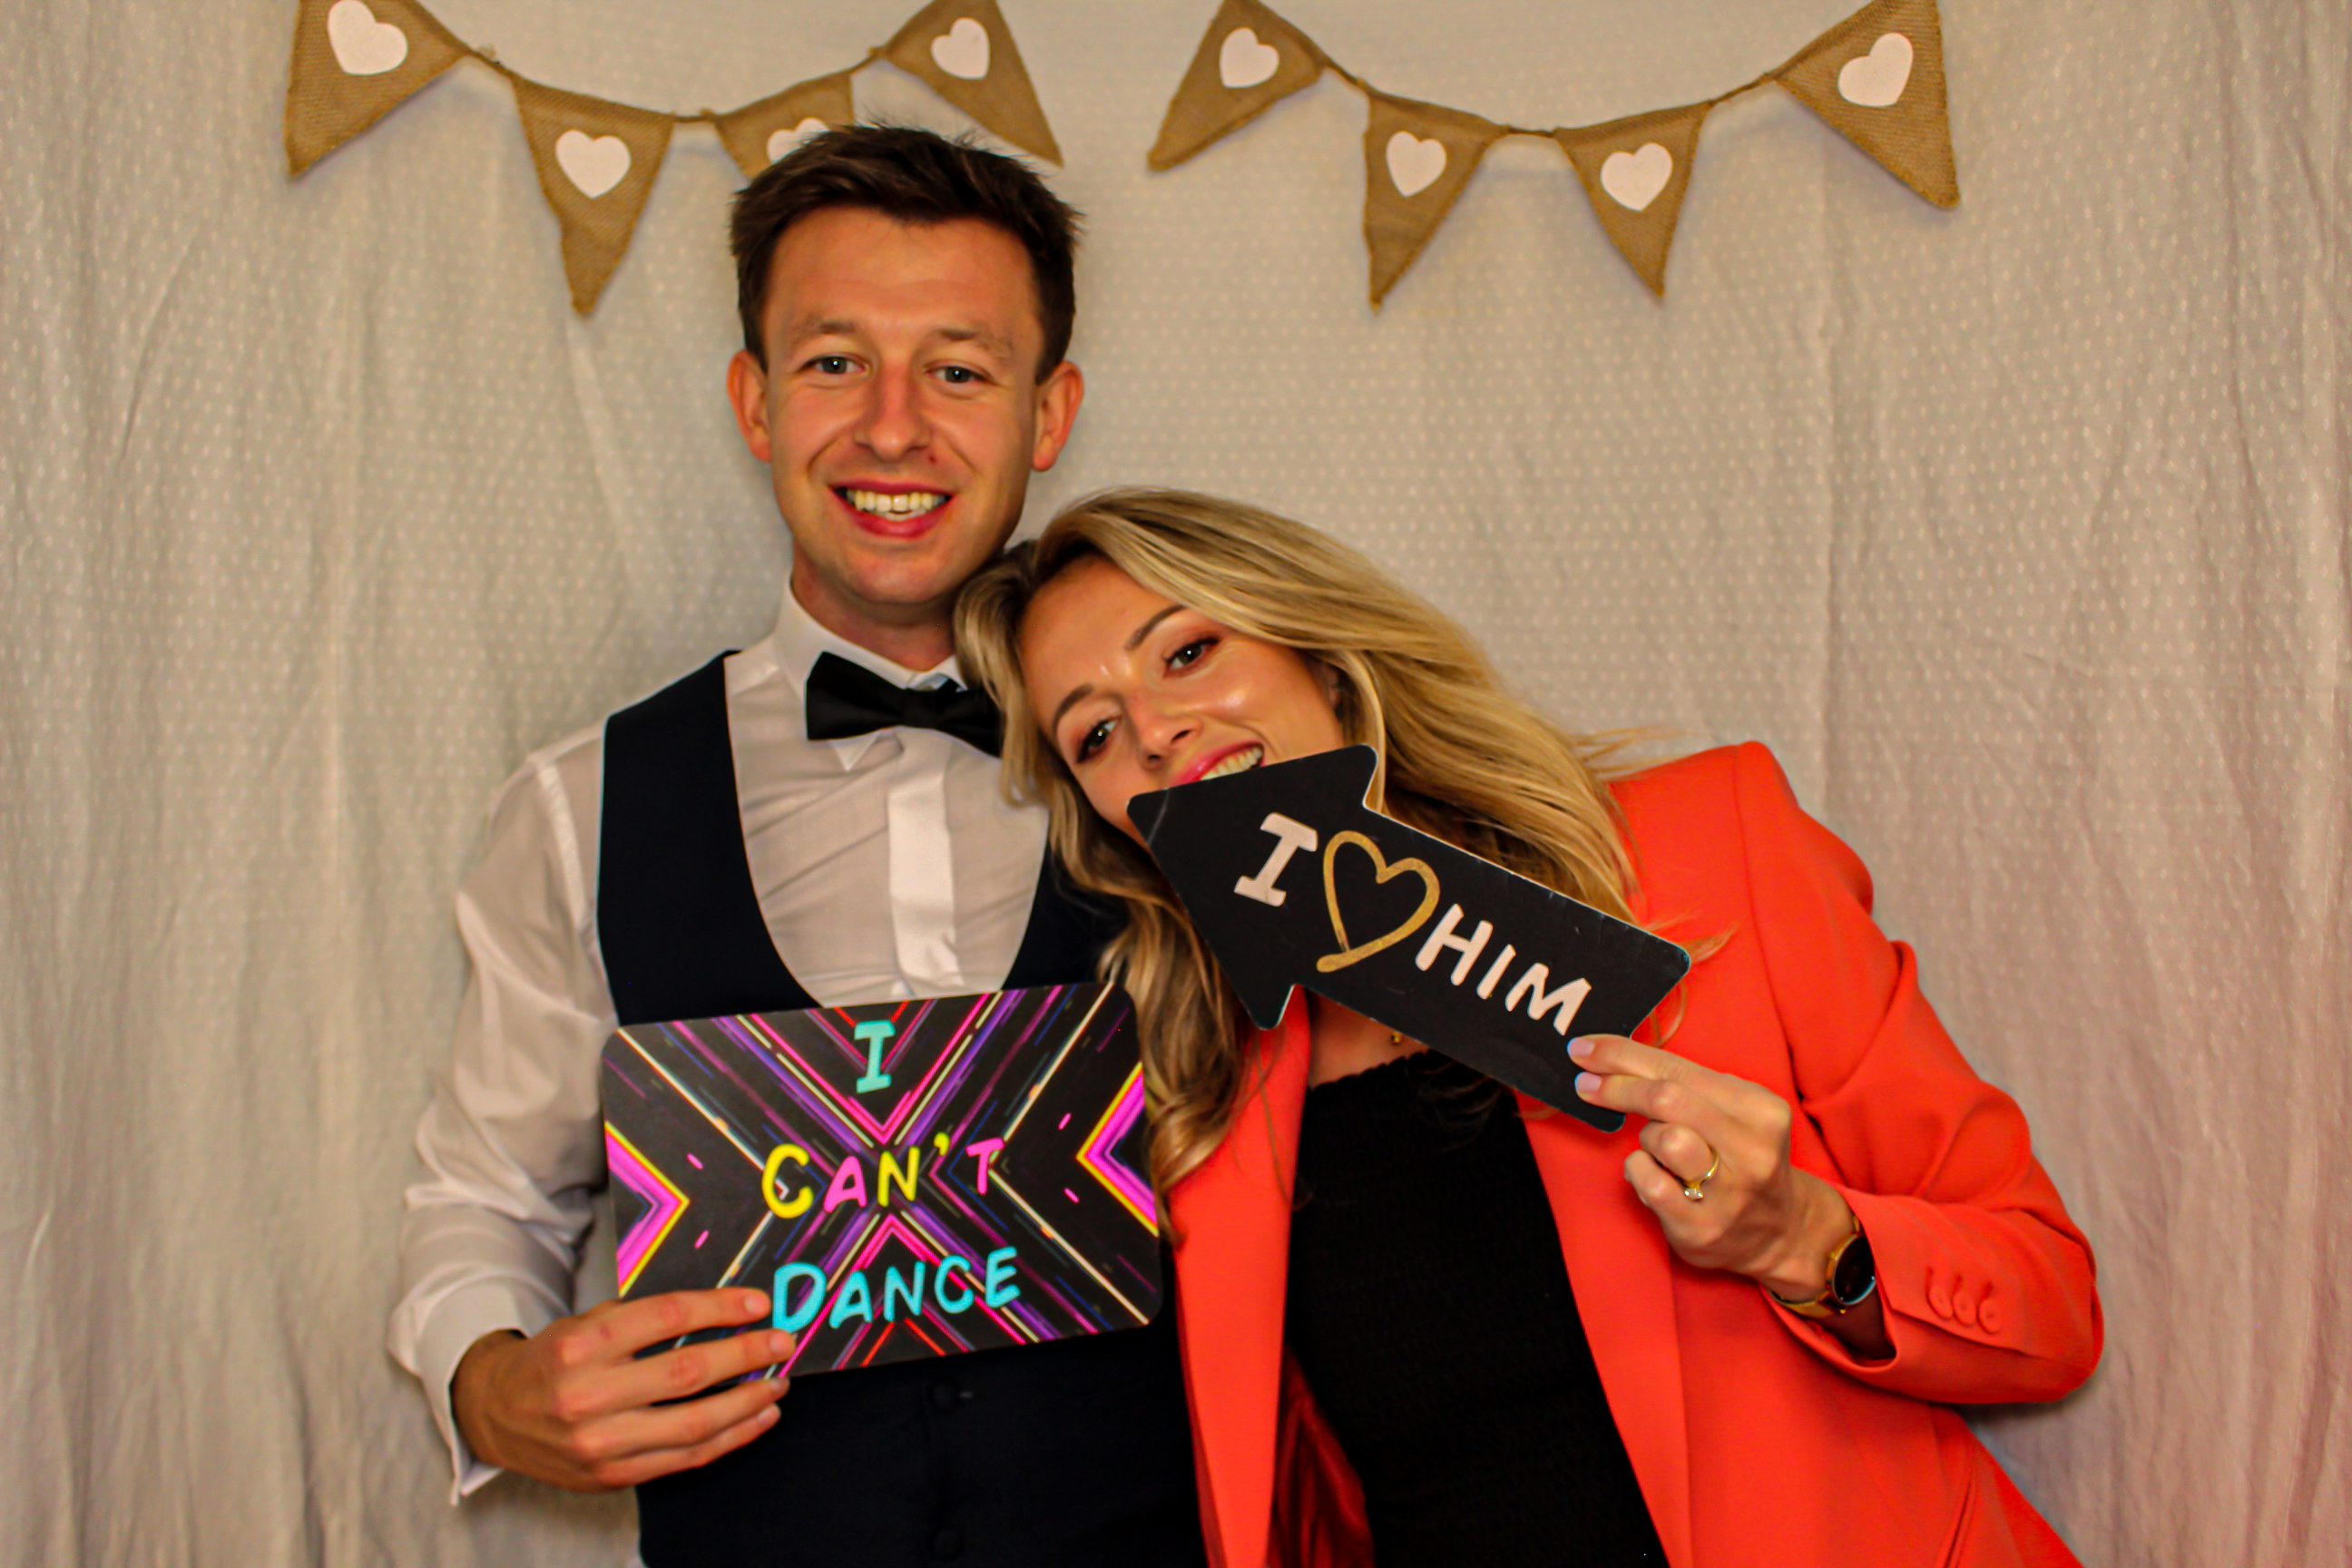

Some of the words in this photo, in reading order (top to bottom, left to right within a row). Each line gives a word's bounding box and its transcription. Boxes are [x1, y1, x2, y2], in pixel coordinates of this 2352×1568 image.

[1233, 811, 1318, 907] I
[1414, 903, 1592, 1037] HIM
[853, 1019, 896, 1093] I
[761, 1132, 1005, 1219] CAN'T
[772, 1246, 1022, 1334] DANCE
